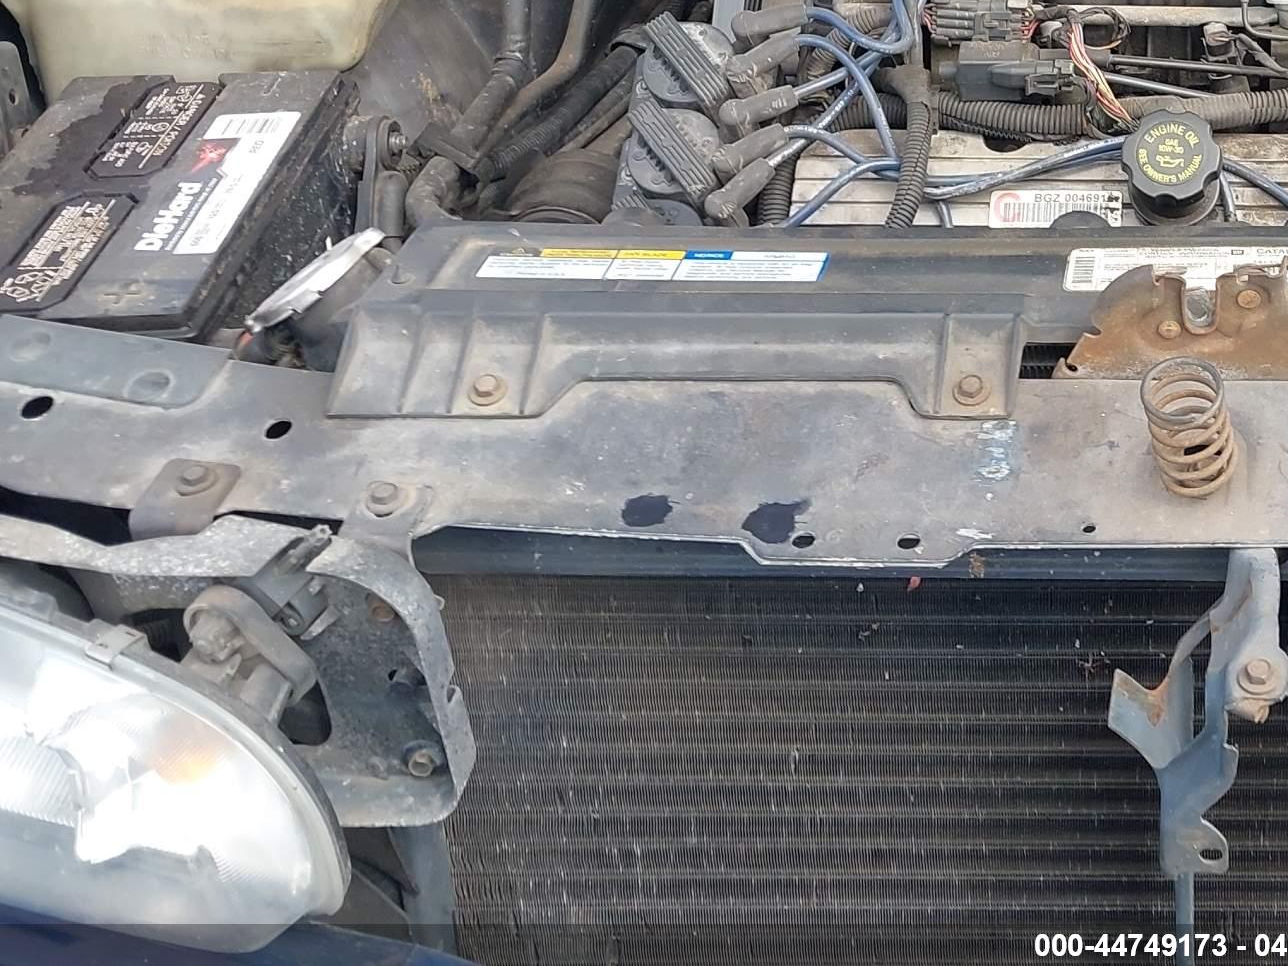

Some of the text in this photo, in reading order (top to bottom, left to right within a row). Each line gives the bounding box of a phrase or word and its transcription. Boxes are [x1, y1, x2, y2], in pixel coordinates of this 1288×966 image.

[1144, 122, 1200, 149] ENGINE OIL
[1164, 138, 1179, 146] SAE
[1138, 148, 1203, 183] SEE OWNER'S MANUAL
[1034, 193, 1114, 203] BGZ 004691
[133, 181, 203, 251] DieHard
